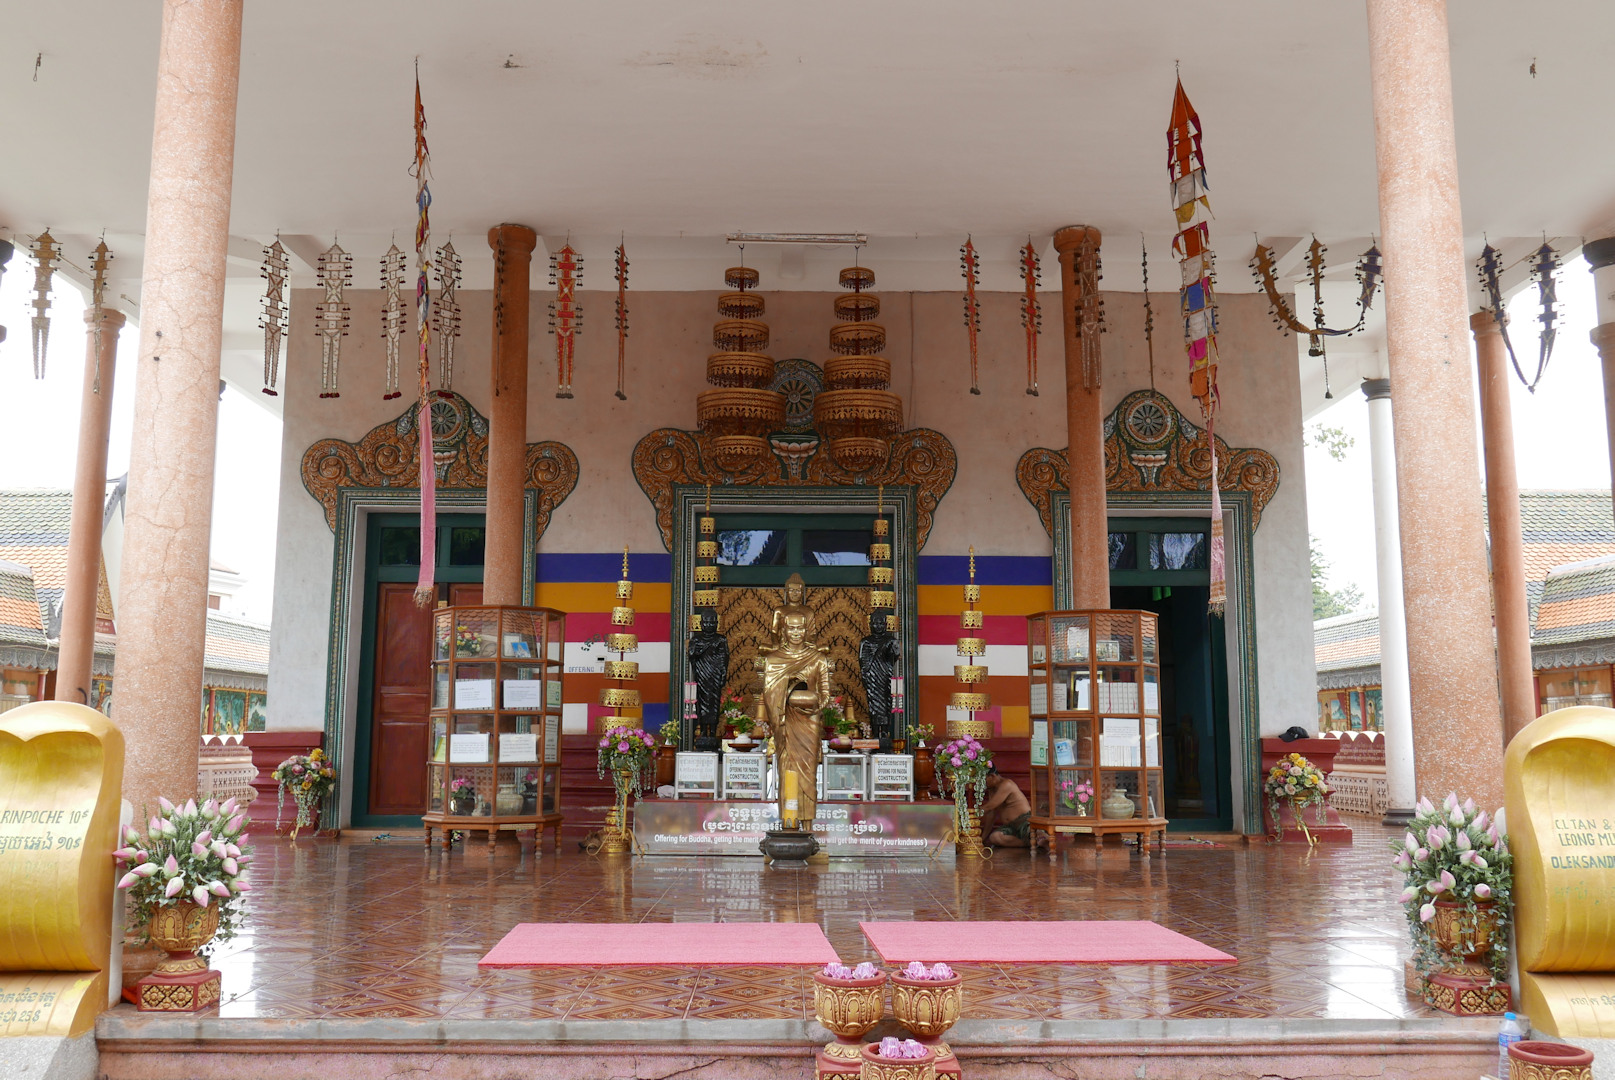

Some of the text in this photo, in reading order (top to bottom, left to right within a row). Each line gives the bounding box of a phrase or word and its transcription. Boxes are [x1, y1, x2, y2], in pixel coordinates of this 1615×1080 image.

[0, 810, 64, 824] RINPOCHE
[654, 834, 678, 844] Offering
[679, 834, 688, 843] for
[733, 835, 743, 843] the
[743, 835, 759, 843] merit
[826, 836, 837, 844] will
[837, 836, 847, 846] get
[848, 836, 858, 844] the
[859, 837, 875, 845] merit
[875, 837, 883, 845] of
[1558, 832, 1595, 847] LEONG
[1551, 855, 1615, 870] OLEKSAND
